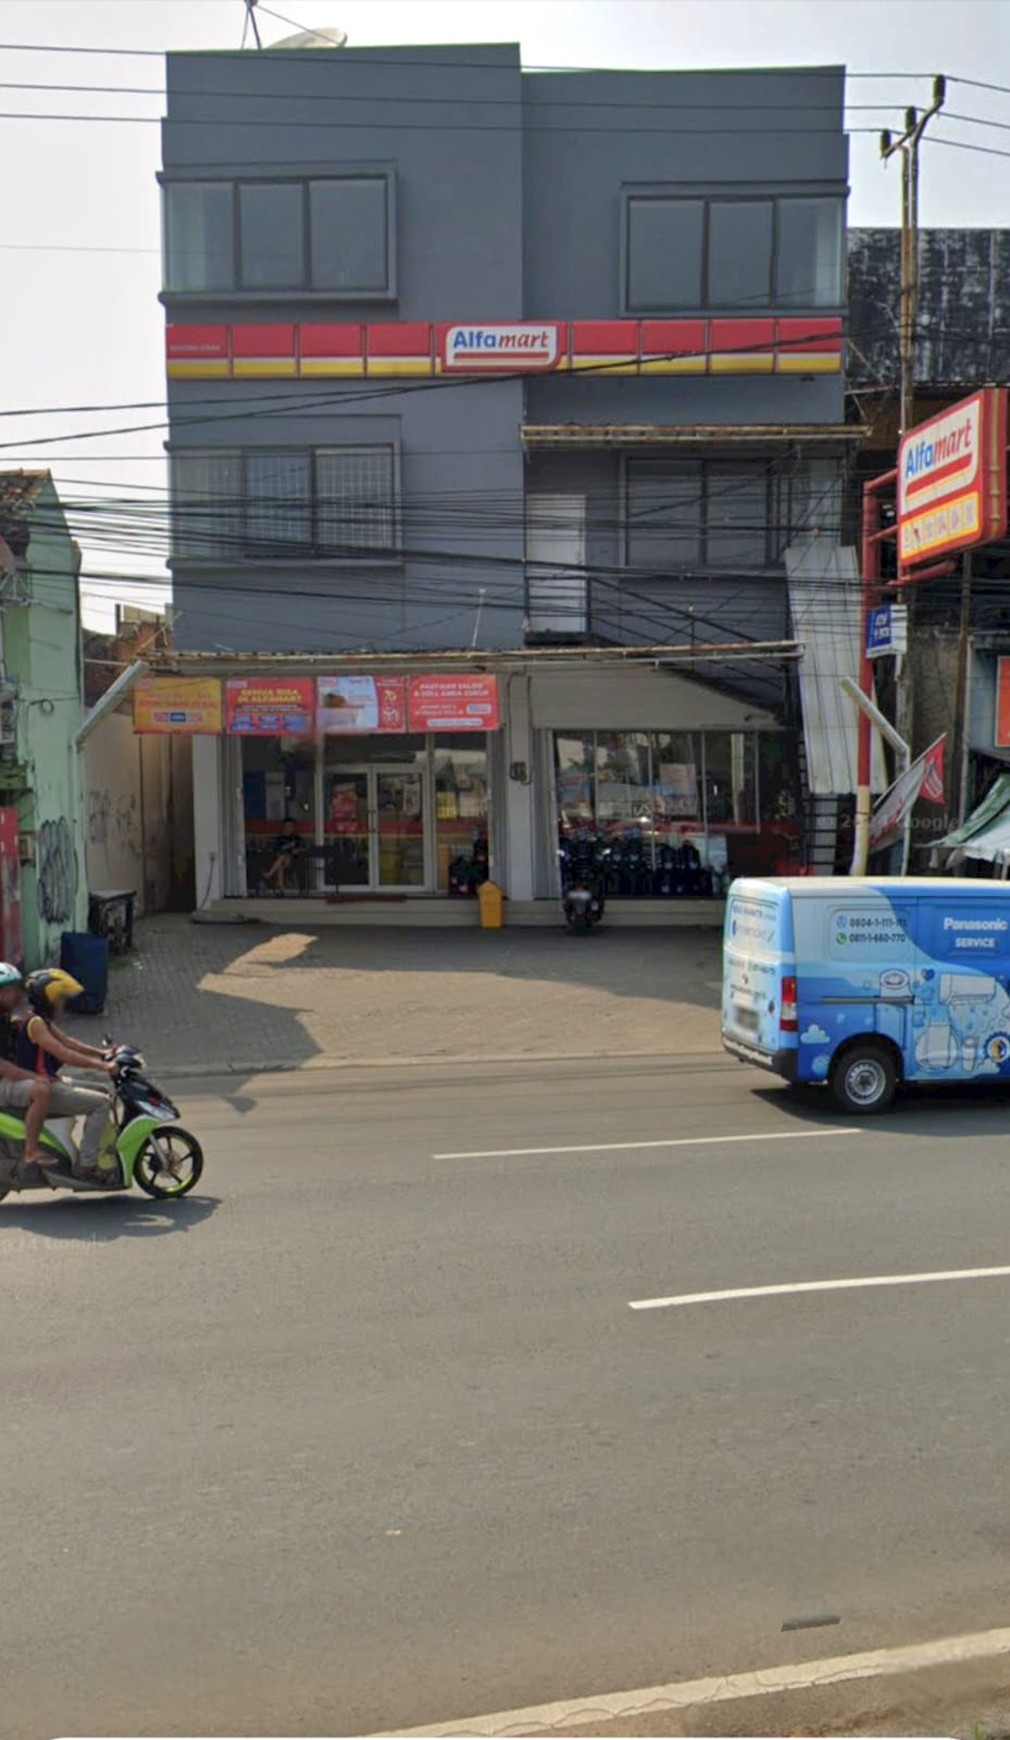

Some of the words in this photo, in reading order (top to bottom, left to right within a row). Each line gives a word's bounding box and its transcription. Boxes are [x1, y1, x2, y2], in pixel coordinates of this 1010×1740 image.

[453, 330, 549, 348] Alfamart
[905, 418, 973, 478] Alfamart
[944, 917, 1008, 930] Panasonic
[955, 937, 996, 948] SERVICE
